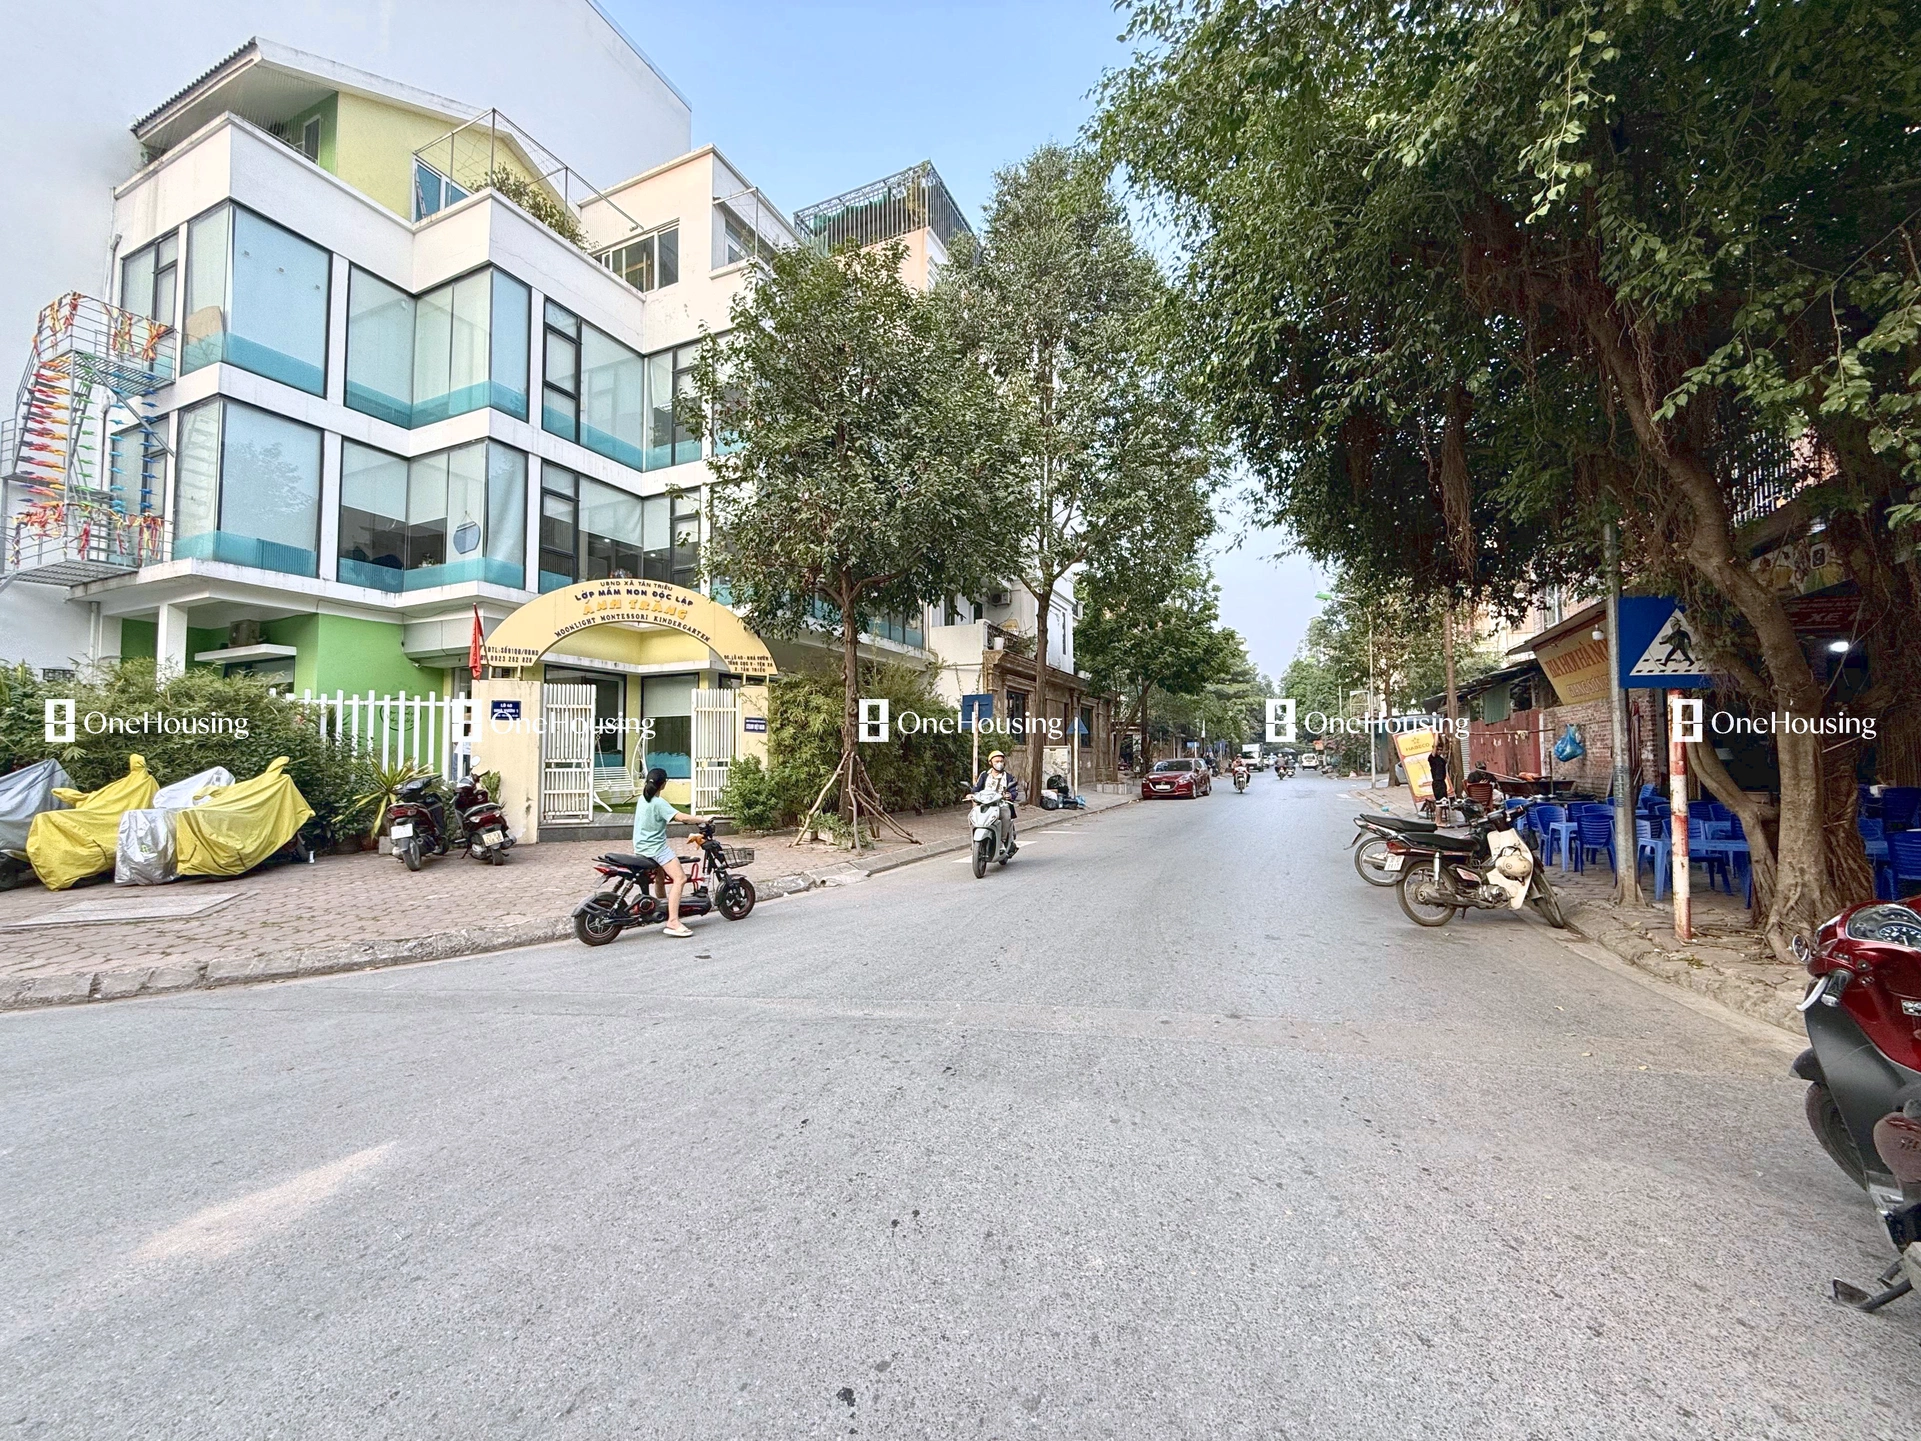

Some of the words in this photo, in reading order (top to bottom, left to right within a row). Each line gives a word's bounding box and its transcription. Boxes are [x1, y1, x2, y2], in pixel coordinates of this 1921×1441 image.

[574, 590, 595, 601] LỚP
[626, 588, 648, 596] NON
[652, 590, 672, 601] ĐỘC
[675, 596, 694, 606] LẬP
[583, 599, 622, 616] ÁNH
[628, 600, 688, 620] TRĂNG
[554, 618, 596, 638] MOONLIGHT
[654, 616, 711, 642] KINDERGARTEN
[1406, 742, 1430, 752] HABECO
